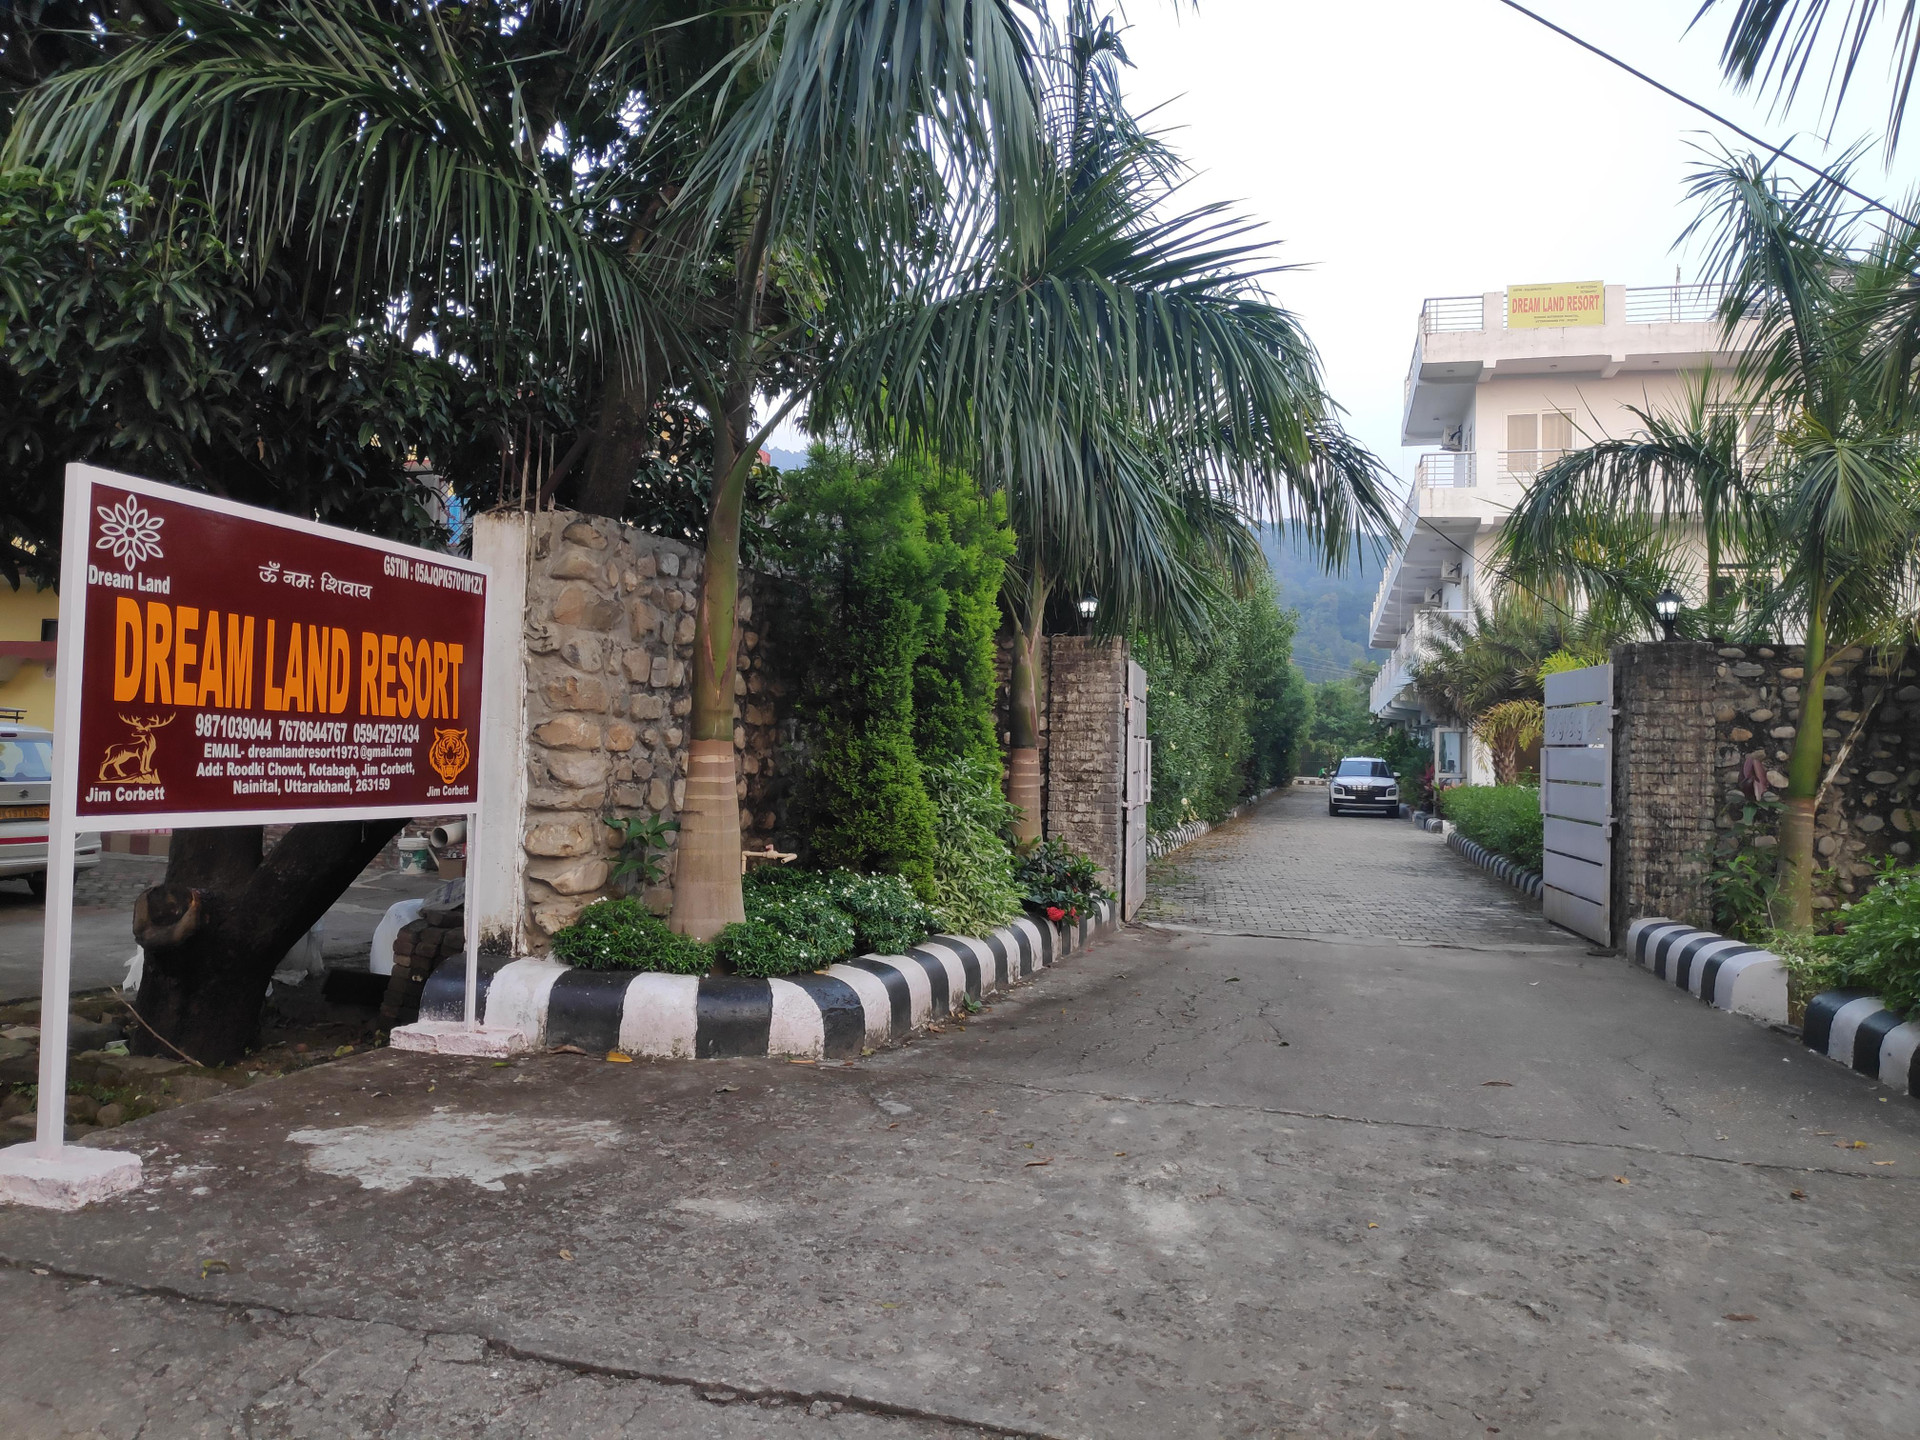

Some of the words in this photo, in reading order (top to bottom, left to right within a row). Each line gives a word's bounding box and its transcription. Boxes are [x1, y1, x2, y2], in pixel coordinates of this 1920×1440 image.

[1512, 297, 1540, 313] DREAM
[1543, 296, 1564, 312] LAND
[1567, 295, 1600, 311] RESORT
[384, 555, 409, 579] GSTIN
[88, 564, 134, 589] Dream
[138, 572, 170, 594] Land
[283, 571, 314, 589] नमः
[321, 572, 373, 600] शिवाय
[114, 597, 254, 709] DREAM
[264, 619, 350, 713] LAND
[360, 632, 463, 719] RESORT
[195, 713, 272, 740] 9871039044
[279, 719, 347, 743] 7678644767
[353, 722, 420, 744] 05947297434
[204, 743, 246, 758] EMAIL-
[196, 762, 223, 776] Add:
[227, 762, 264, 776] Roodki
[268, 762, 306, 779] Chowk,
[309, 763, 359, 779] Kotabagh,
[362, 763, 378, 776] Jim
[381, 762, 415, 775] Corbett,
[85, 788, 111, 803] Jim
[116, 786, 164, 801] Corbett
[233, 779, 281, 796] Nainital,
[285, 778, 352, 795] Uttarakhand,
[356, 778, 390, 792] 263159
[427, 786, 440, 797] Jim
[443, 785, 469, 795] Corbett
